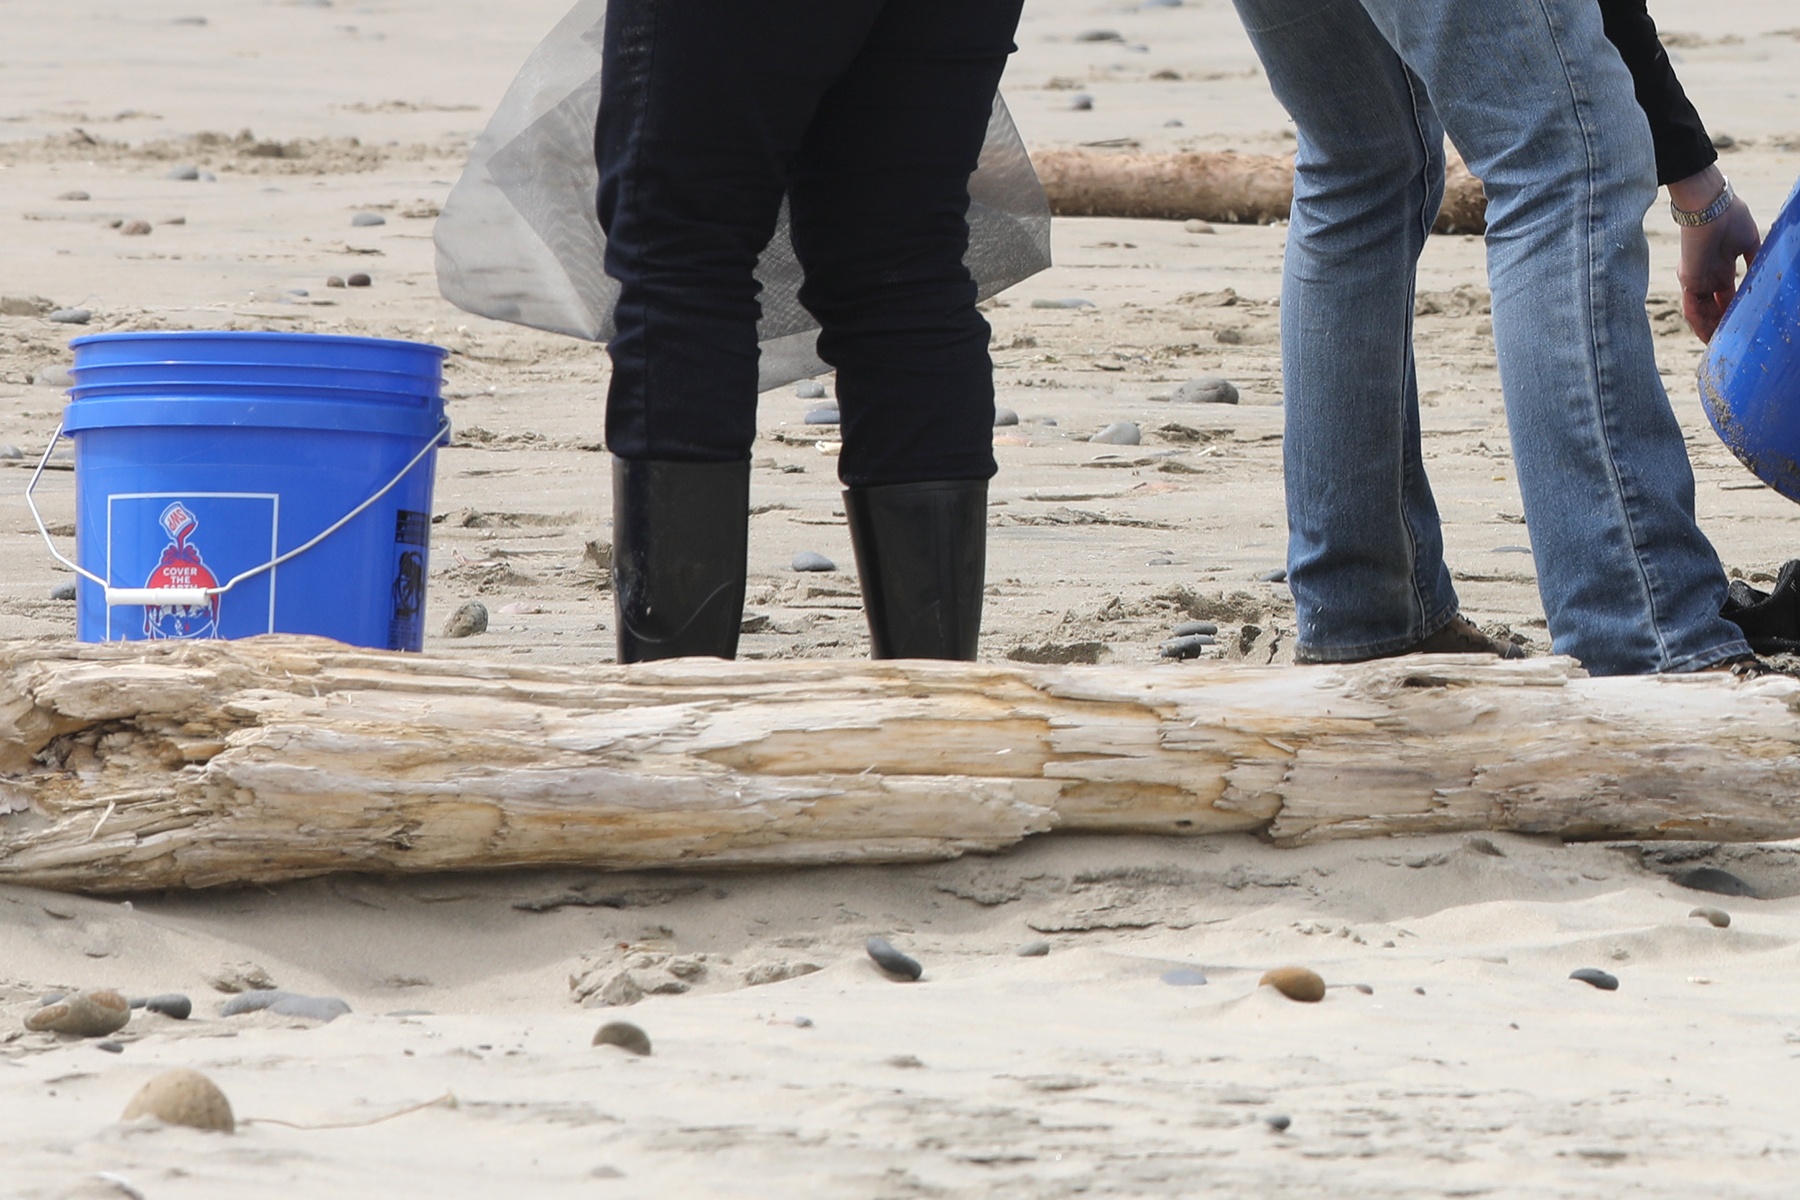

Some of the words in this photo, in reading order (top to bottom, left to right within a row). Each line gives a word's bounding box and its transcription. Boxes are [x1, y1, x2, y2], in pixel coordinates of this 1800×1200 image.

[168, 508, 187, 531] SWP
[163, 567, 198, 576] COVER
[170, 576, 191, 584] THE
